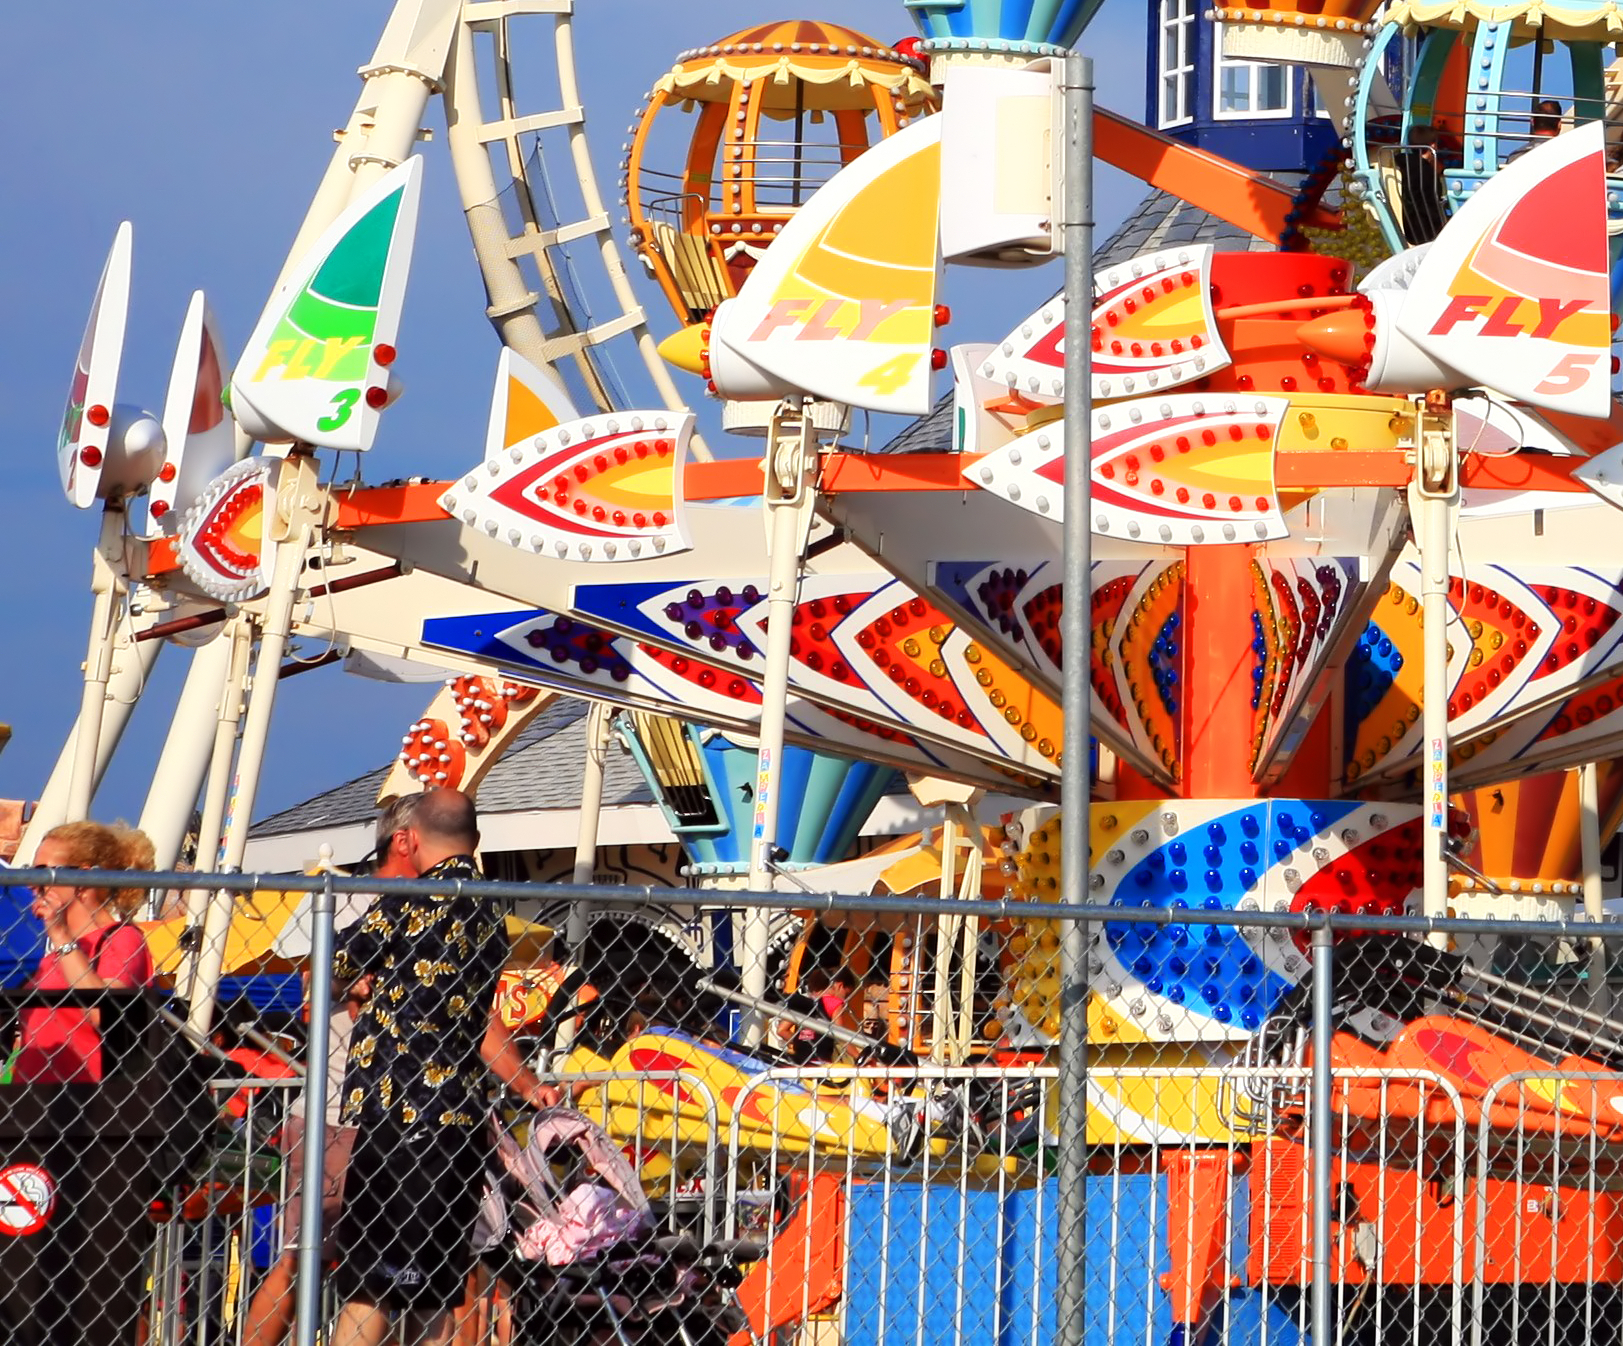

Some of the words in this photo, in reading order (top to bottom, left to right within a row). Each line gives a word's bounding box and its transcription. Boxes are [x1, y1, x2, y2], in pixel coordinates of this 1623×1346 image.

[747, 299, 917, 342] FLY
[1427, 295, 1594, 339] FLY
[250, 336, 366, 383] FLY
[854, 353, 924, 395] 4
[1533, 353, 1601, 395] 5
[316, 387, 361, 432] 3
